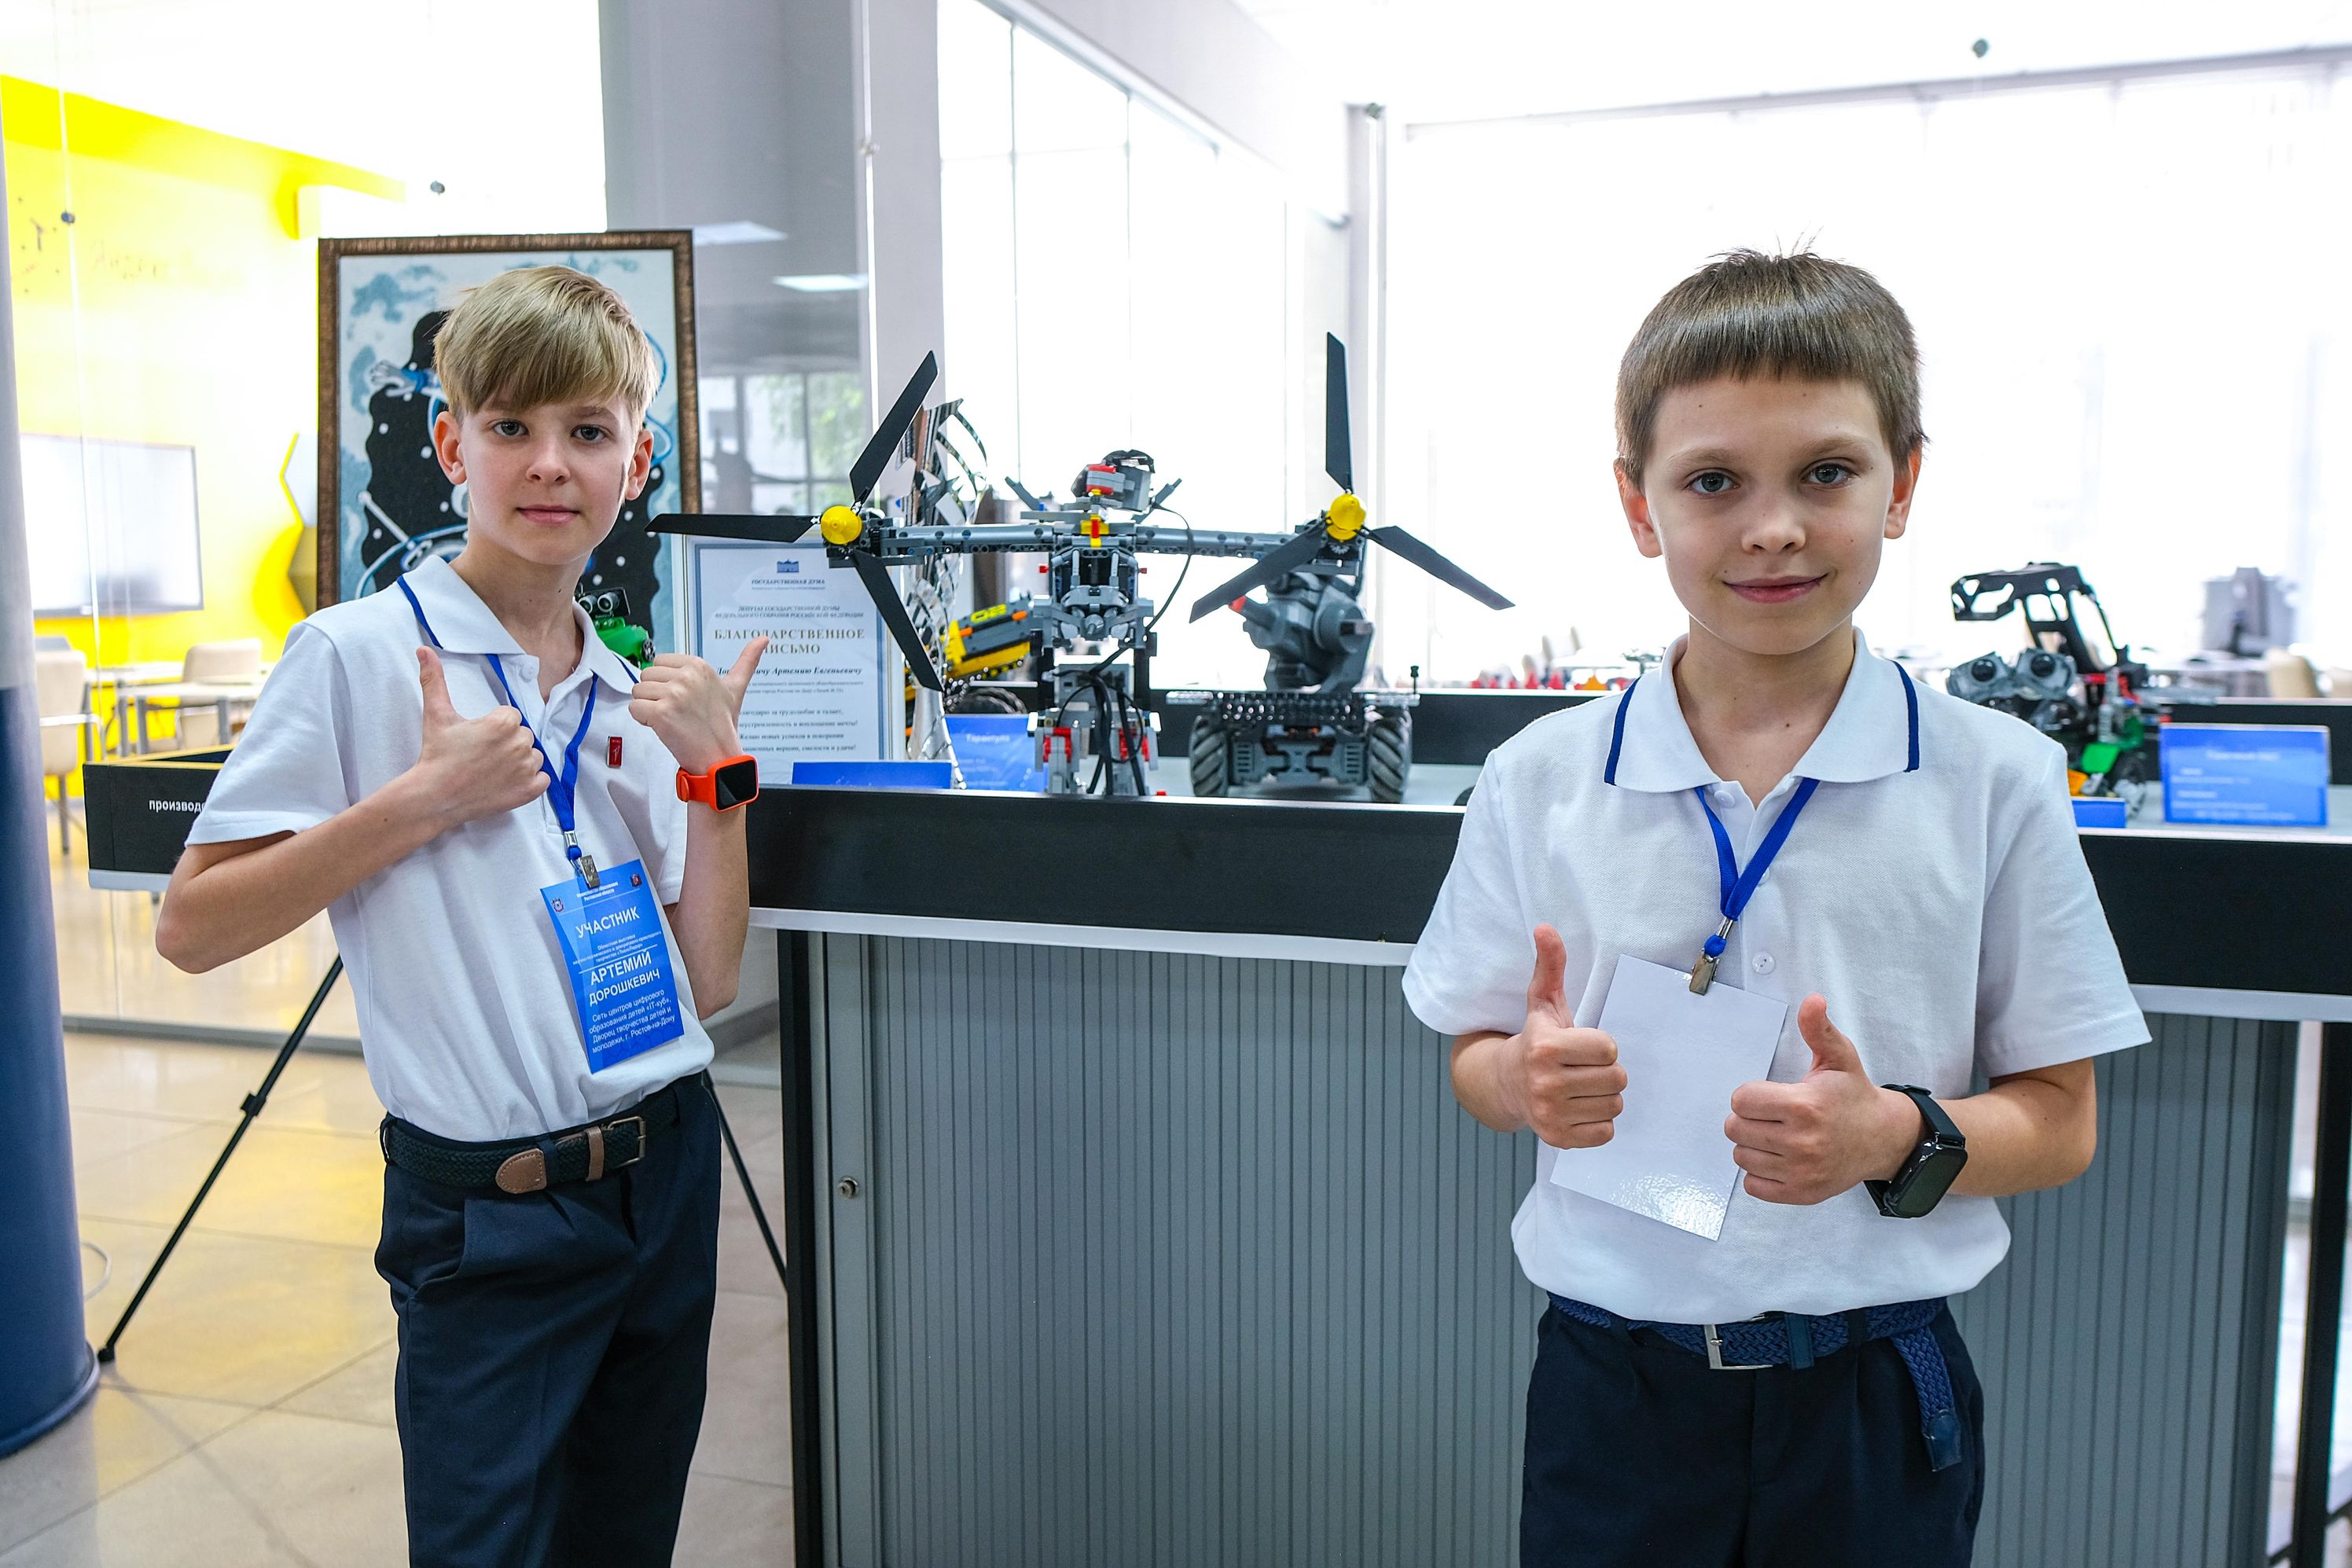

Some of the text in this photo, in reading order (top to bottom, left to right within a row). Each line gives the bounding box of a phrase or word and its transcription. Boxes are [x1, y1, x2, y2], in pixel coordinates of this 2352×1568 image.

[771, 667, 812, 676] Артемию
[575, 906, 640, 938] УЧАСТНИК
[590, 949, 652, 986] АРТЕМИЙ
[589, 968, 660, 1007] ДОРОШКЕВИЧ
[589, 1014, 627, 1034] образования
[628, 1006, 645, 1020] детей
[592, 989, 664, 1023] Сеть центров цифрового
[592, 1036, 626, 1054] молодежи,
[630, 1015, 676, 1037] Ростов-на-Дону
[593, 1030, 616, 1044] Дворец
[616, 1015, 649, 1034] творчества
[649, 1008, 667, 1021] детей
